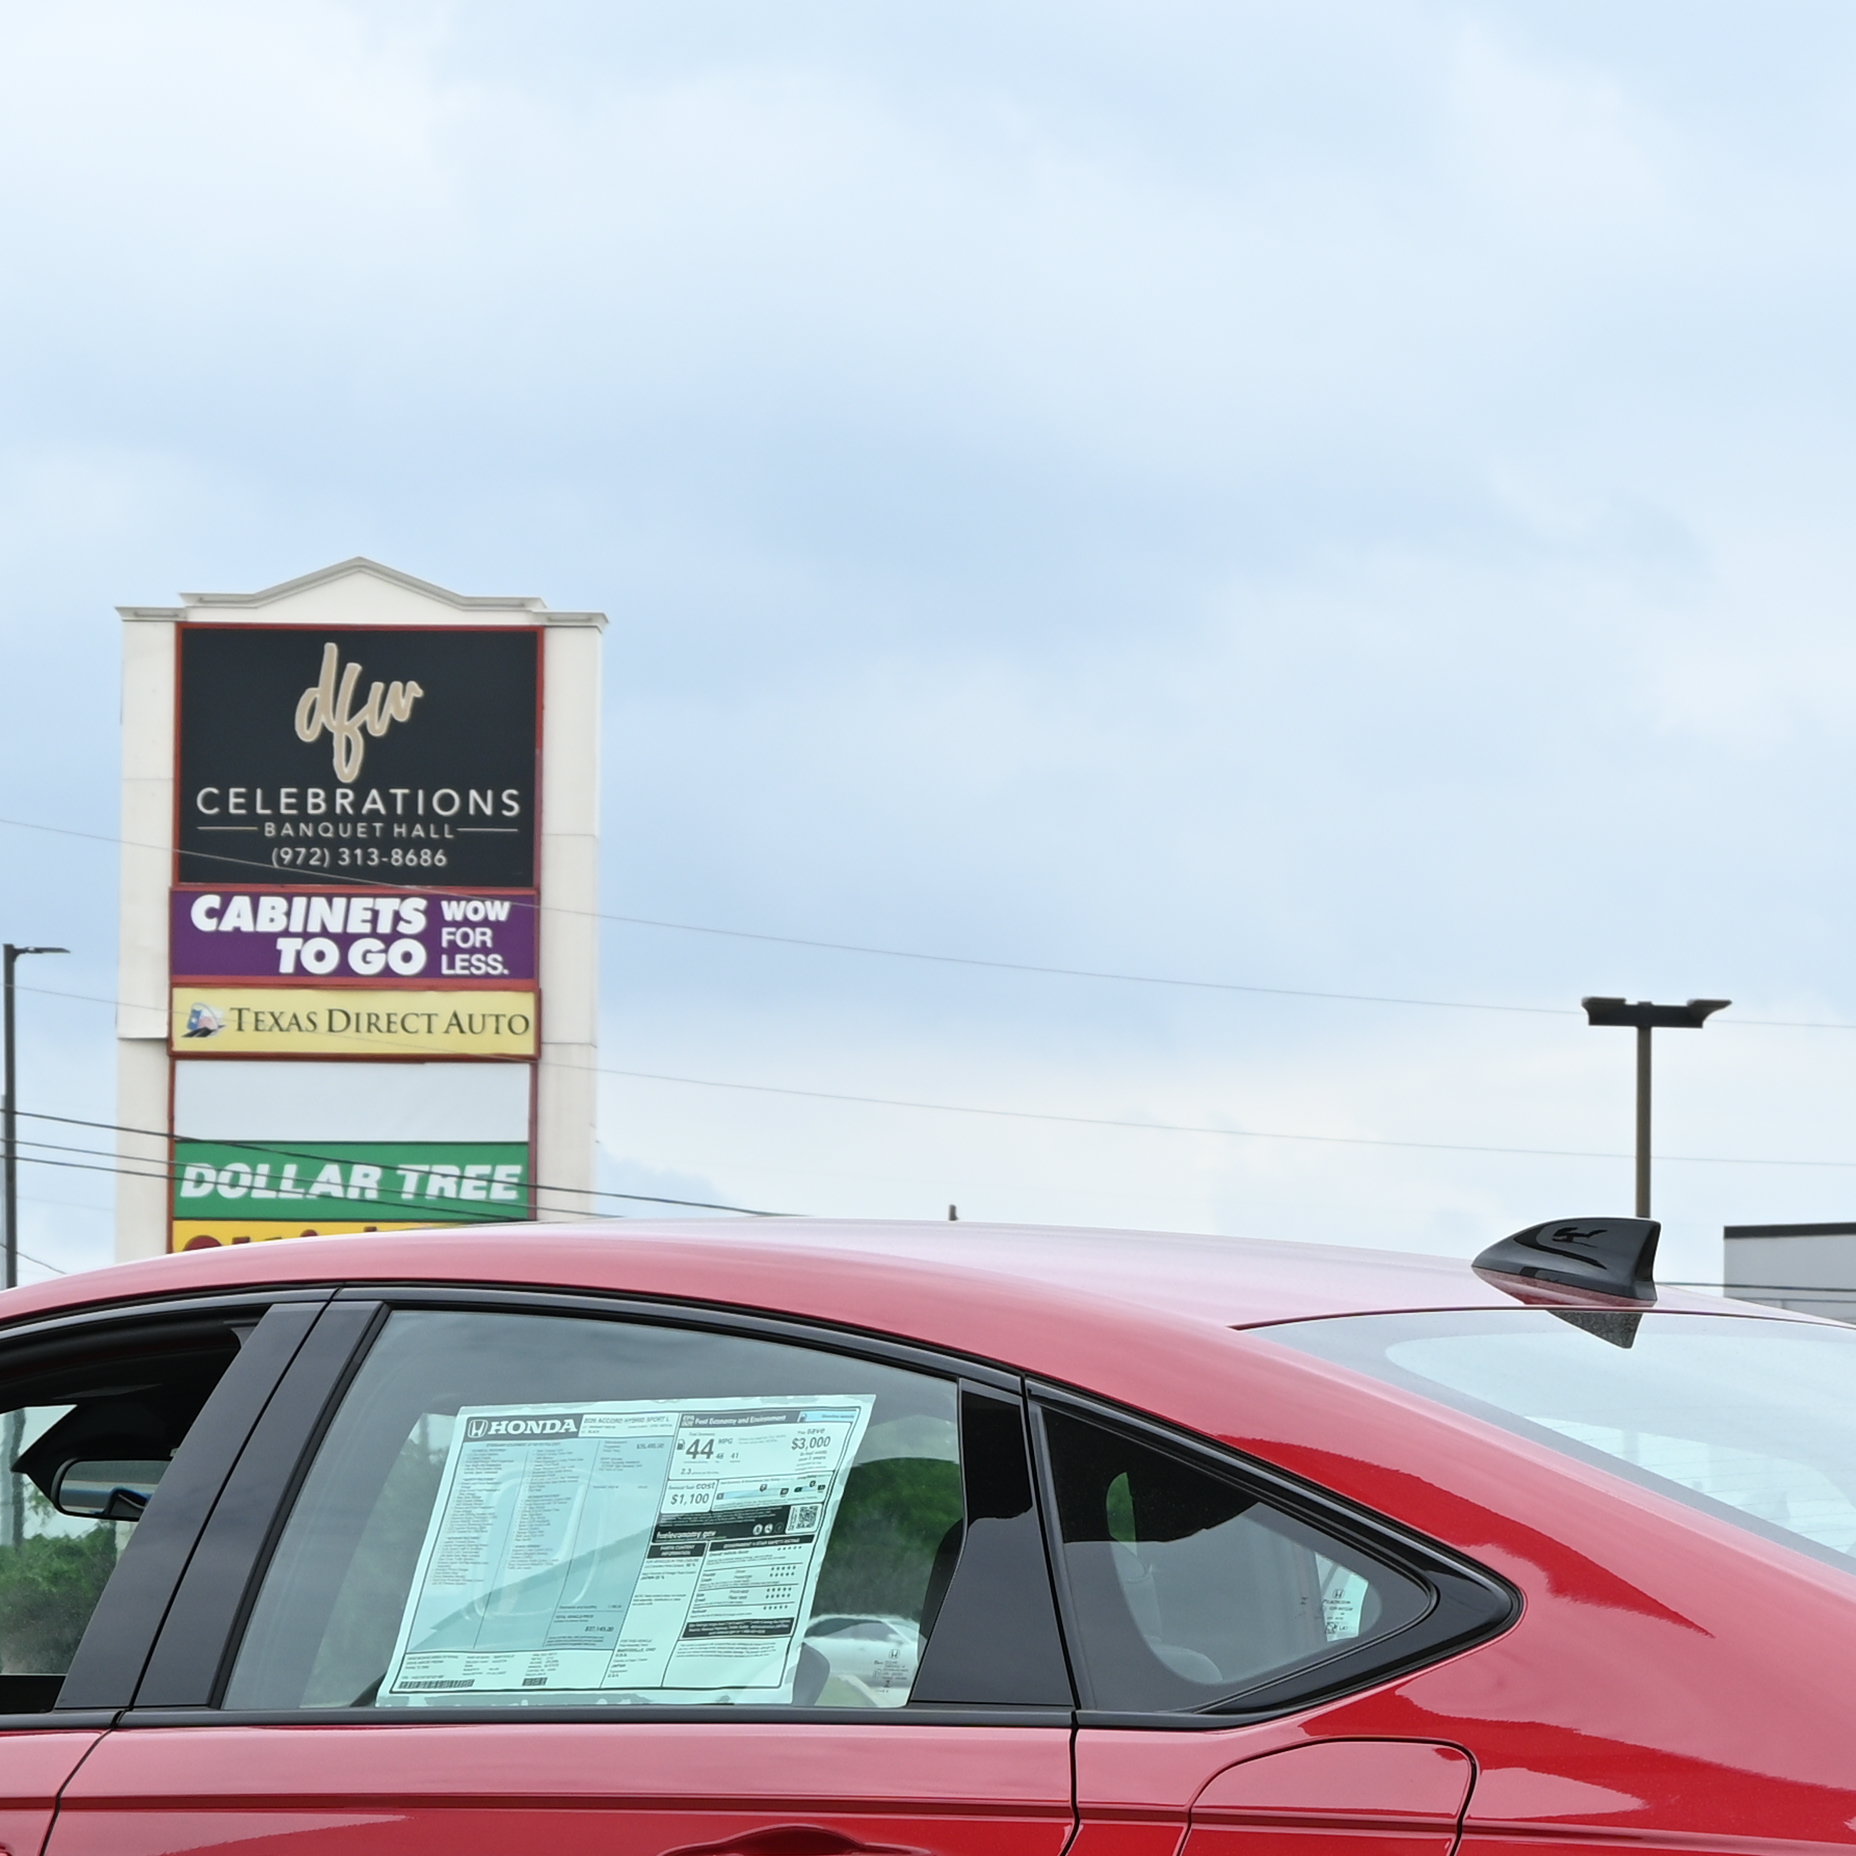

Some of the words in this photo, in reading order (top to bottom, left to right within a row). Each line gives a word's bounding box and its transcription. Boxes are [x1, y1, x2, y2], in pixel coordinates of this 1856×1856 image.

[294, 642, 424, 784] dfw
[196, 787, 520, 817] CELEBRATIONS
[264, 822, 385, 839] BANQUET
[394, 823, 455, 839] HALL
[271, 848, 330, 868] (972)
[338, 848, 448, 867] 313-8686
[190, 894, 428, 935] CABINETS
[440, 900, 512, 922] WOW
[440, 927, 493, 949] FOR
[276, 937, 341, 976] TO
[347, 937, 428, 976] GO
[440, 953, 511, 976] LESS.
[229, 1007, 318, 1034] TEXAS
[326, 1007, 439, 1035] DIRECT
[444, 1010, 530, 1036] AUTO
[179, 1162, 383, 1200] DOLLAR
[395, 1164, 523, 1201] TREE
[487, 1418, 578, 1436] HONDA
[709, 1417, 734, 1426] Economy
[735, 1416, 747, 1424] and
[685, 1438, 715, 1460] 44
[717, 1437, 734, 1445] MPG
[791, 1435, 831, 1452] $3,000
[695, 1481, 716, 1490] cost
[670, 1492, 710, 1506] $1,100
